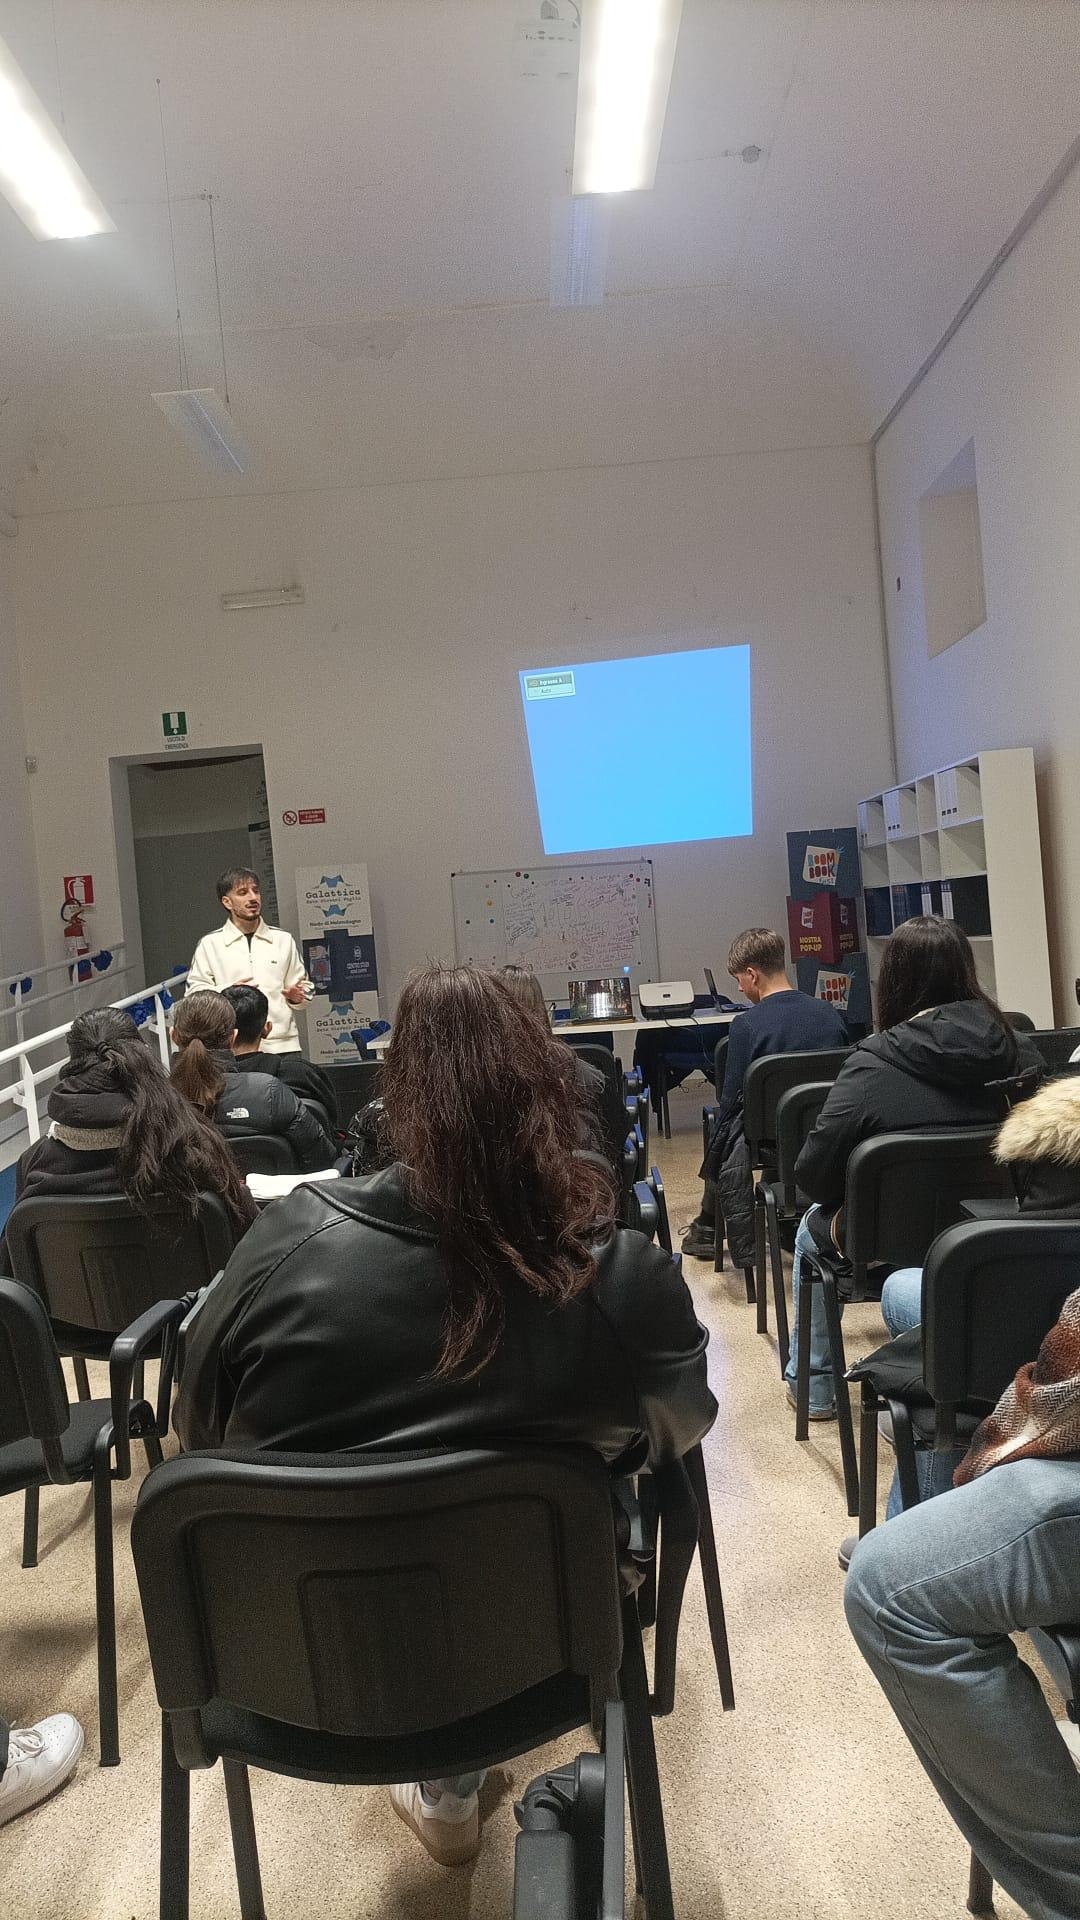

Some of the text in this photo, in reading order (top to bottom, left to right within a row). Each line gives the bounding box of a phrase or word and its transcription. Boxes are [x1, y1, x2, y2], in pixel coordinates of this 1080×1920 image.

[809, 863, 836, 879] BOOK
[305, 888, 361, 899] Galattica
[800, 936, 822, 944] MOSTRA
[800, 944, 823, 952] POP-UP
[315, 1016, 371, 1027] Galattica
